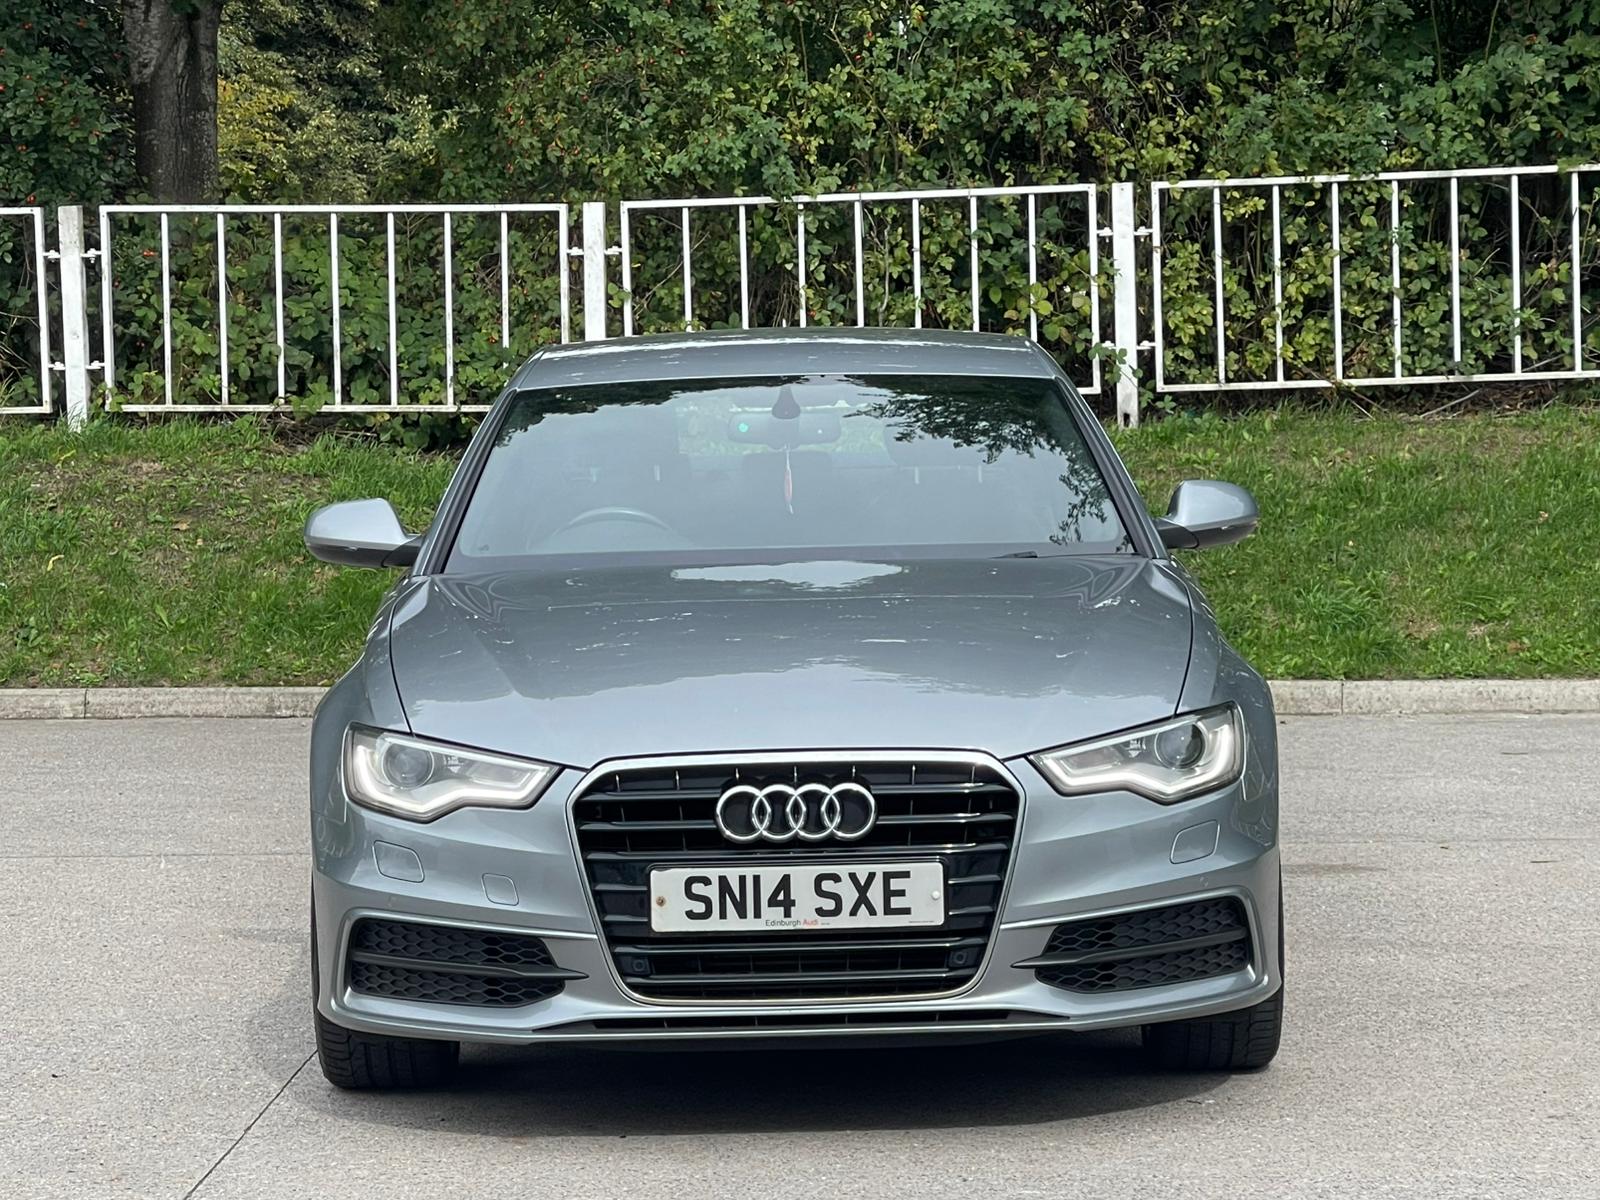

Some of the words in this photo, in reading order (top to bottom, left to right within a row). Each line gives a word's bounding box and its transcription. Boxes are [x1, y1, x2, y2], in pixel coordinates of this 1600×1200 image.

[684, 873, 796, 920] SN14
[813, 871, 912, 918] SXE
[765, 919, 801, 927] Edinburgh
[803, 918, 818, 926] Audi
